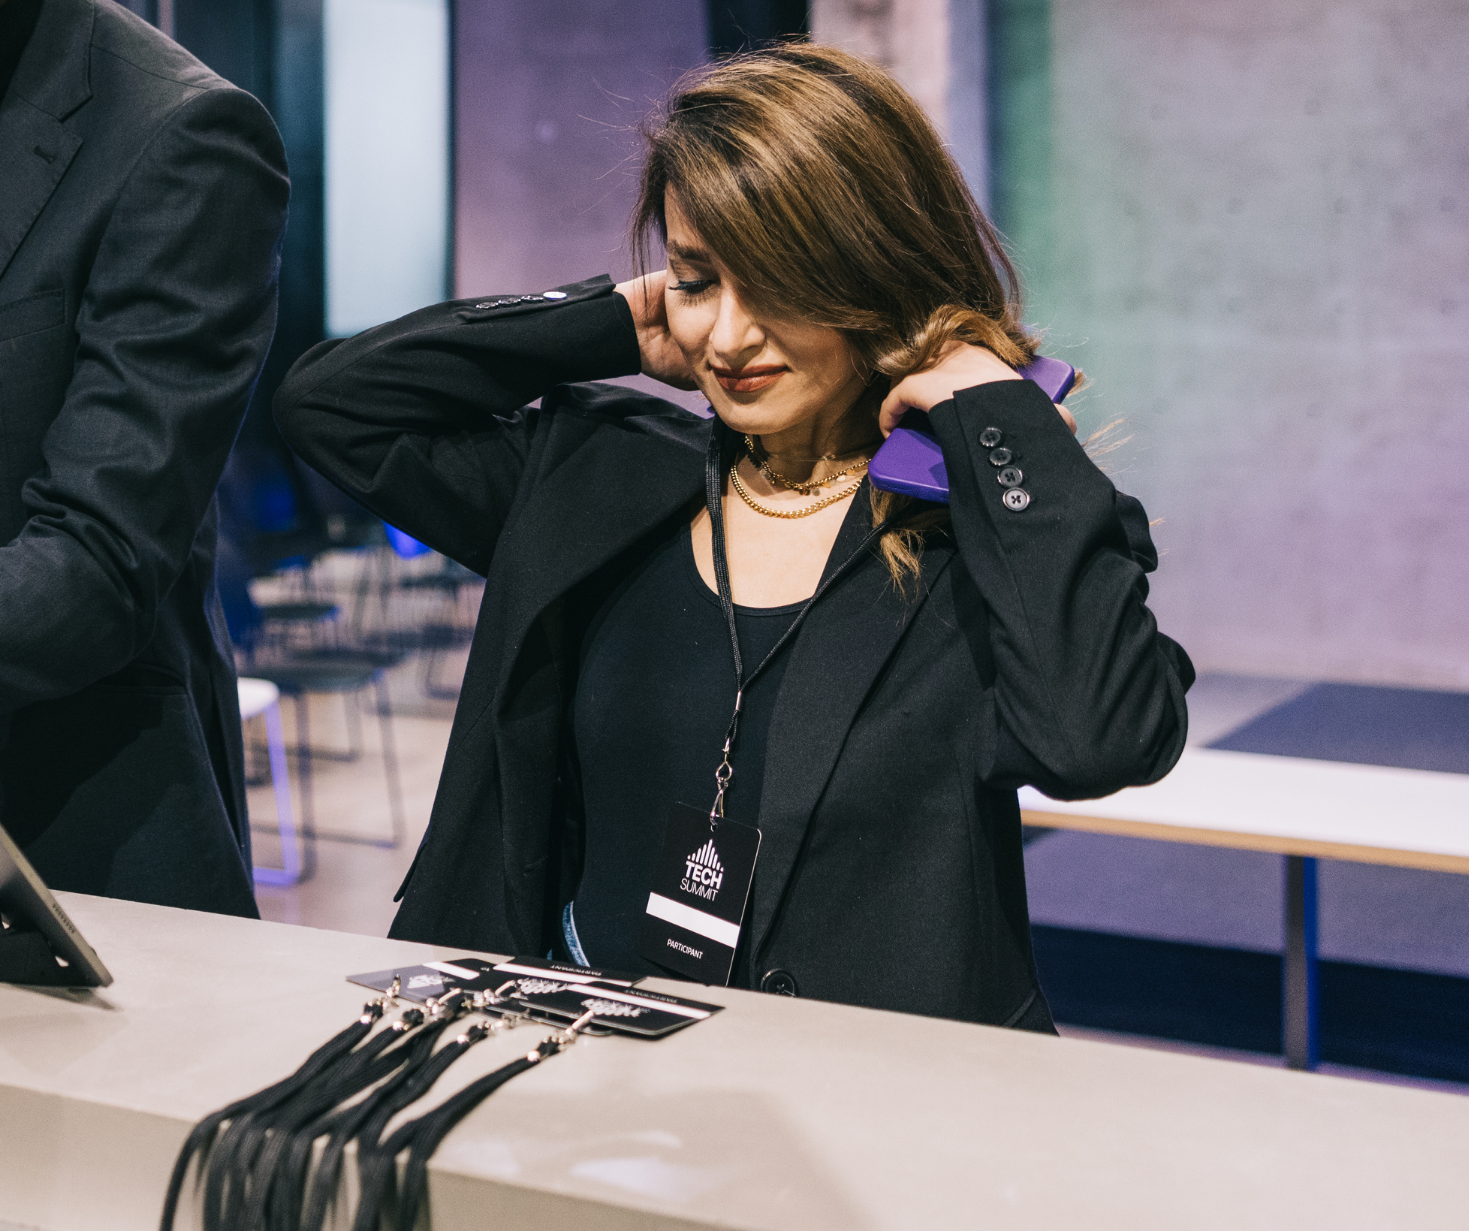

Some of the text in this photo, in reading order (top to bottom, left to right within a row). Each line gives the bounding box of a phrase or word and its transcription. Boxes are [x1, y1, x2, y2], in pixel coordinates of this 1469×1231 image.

[685, 860, 724, 890] TECH
[679, 878, 719, 902] SUMMIT
[666, 938, 704, 960] PARTICIPANT
